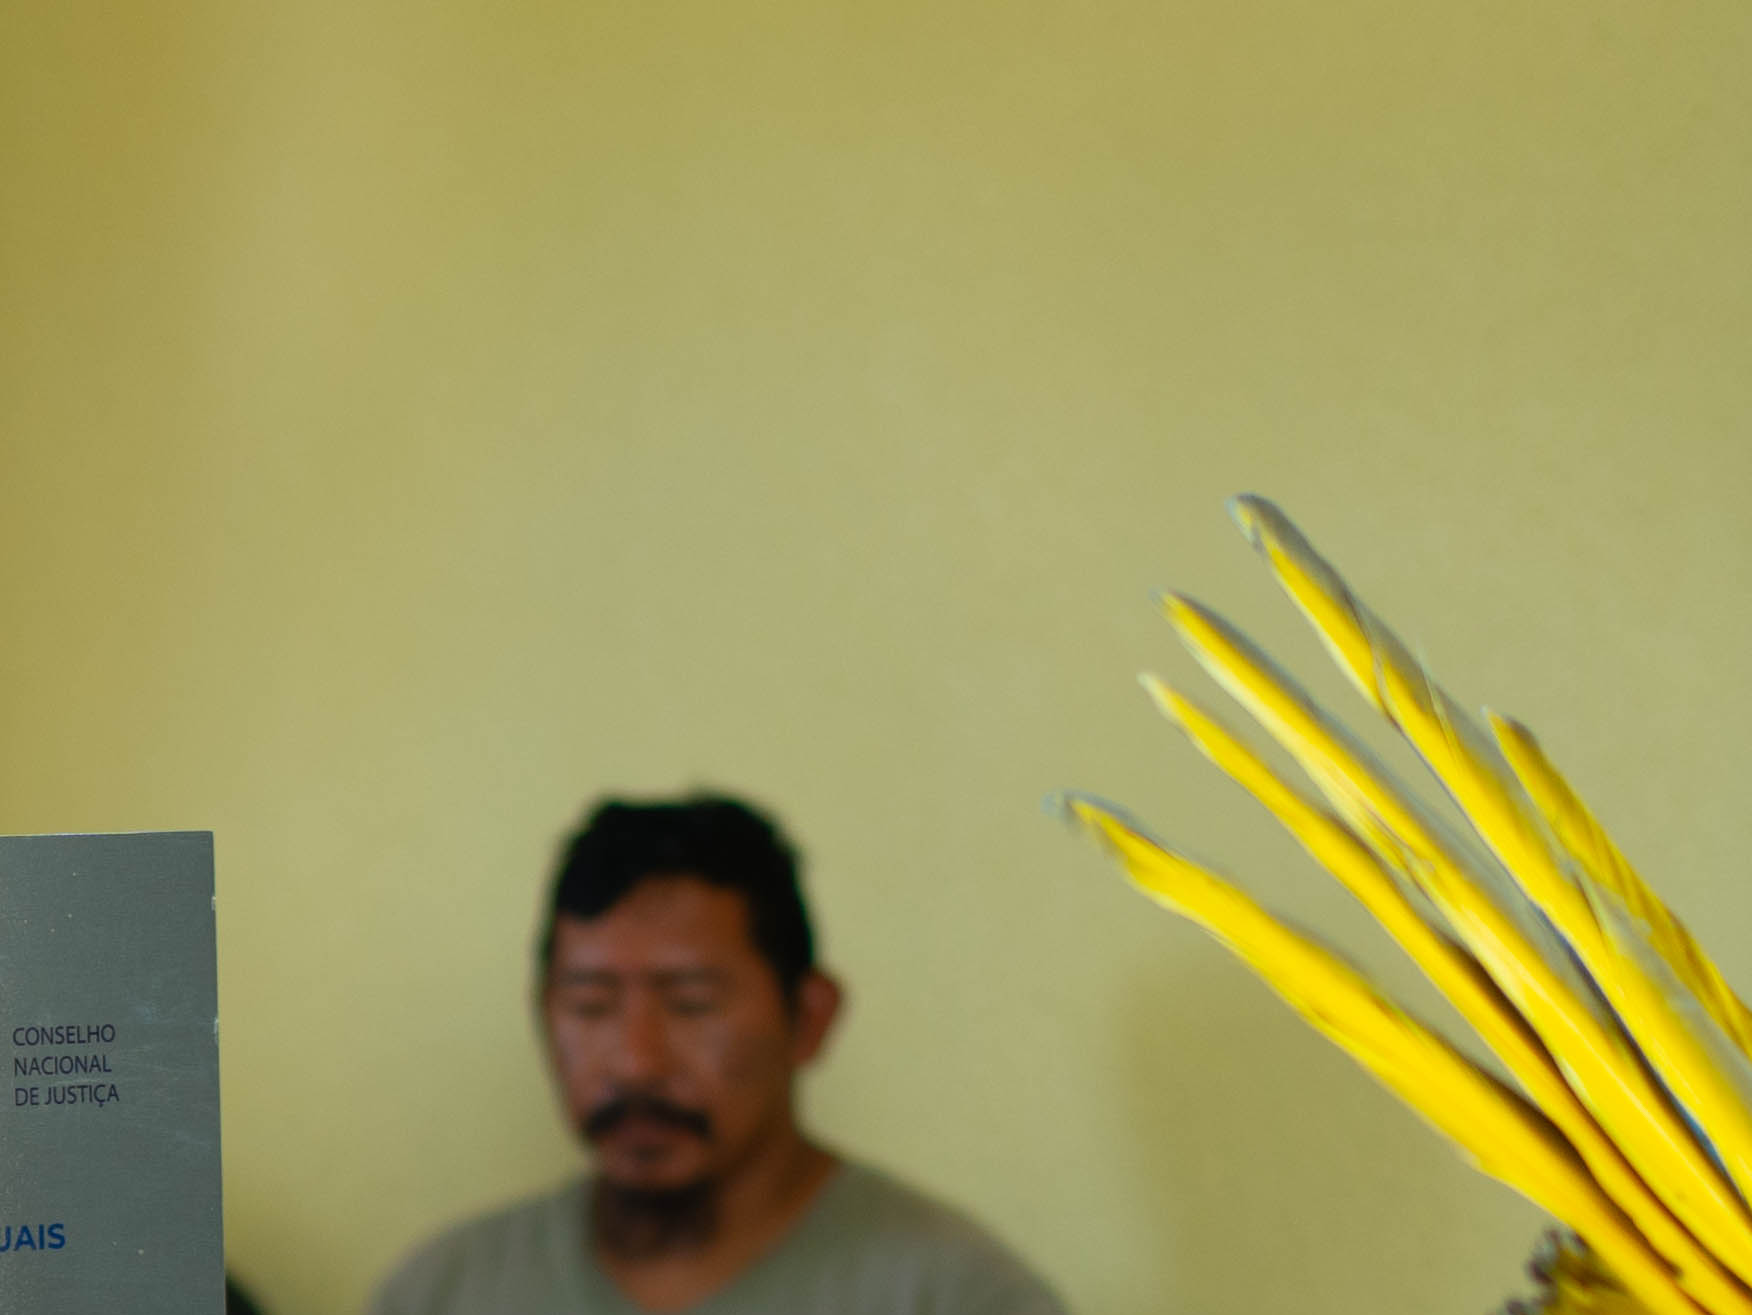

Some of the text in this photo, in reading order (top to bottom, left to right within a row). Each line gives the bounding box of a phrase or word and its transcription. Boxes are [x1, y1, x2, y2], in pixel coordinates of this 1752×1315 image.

[12, 1023, 117, 1047] CONSELHO
[14, 1054, 112, 1077] NACIONAL
[15, 1083, 120, 1109] DE JUSTIÇA
